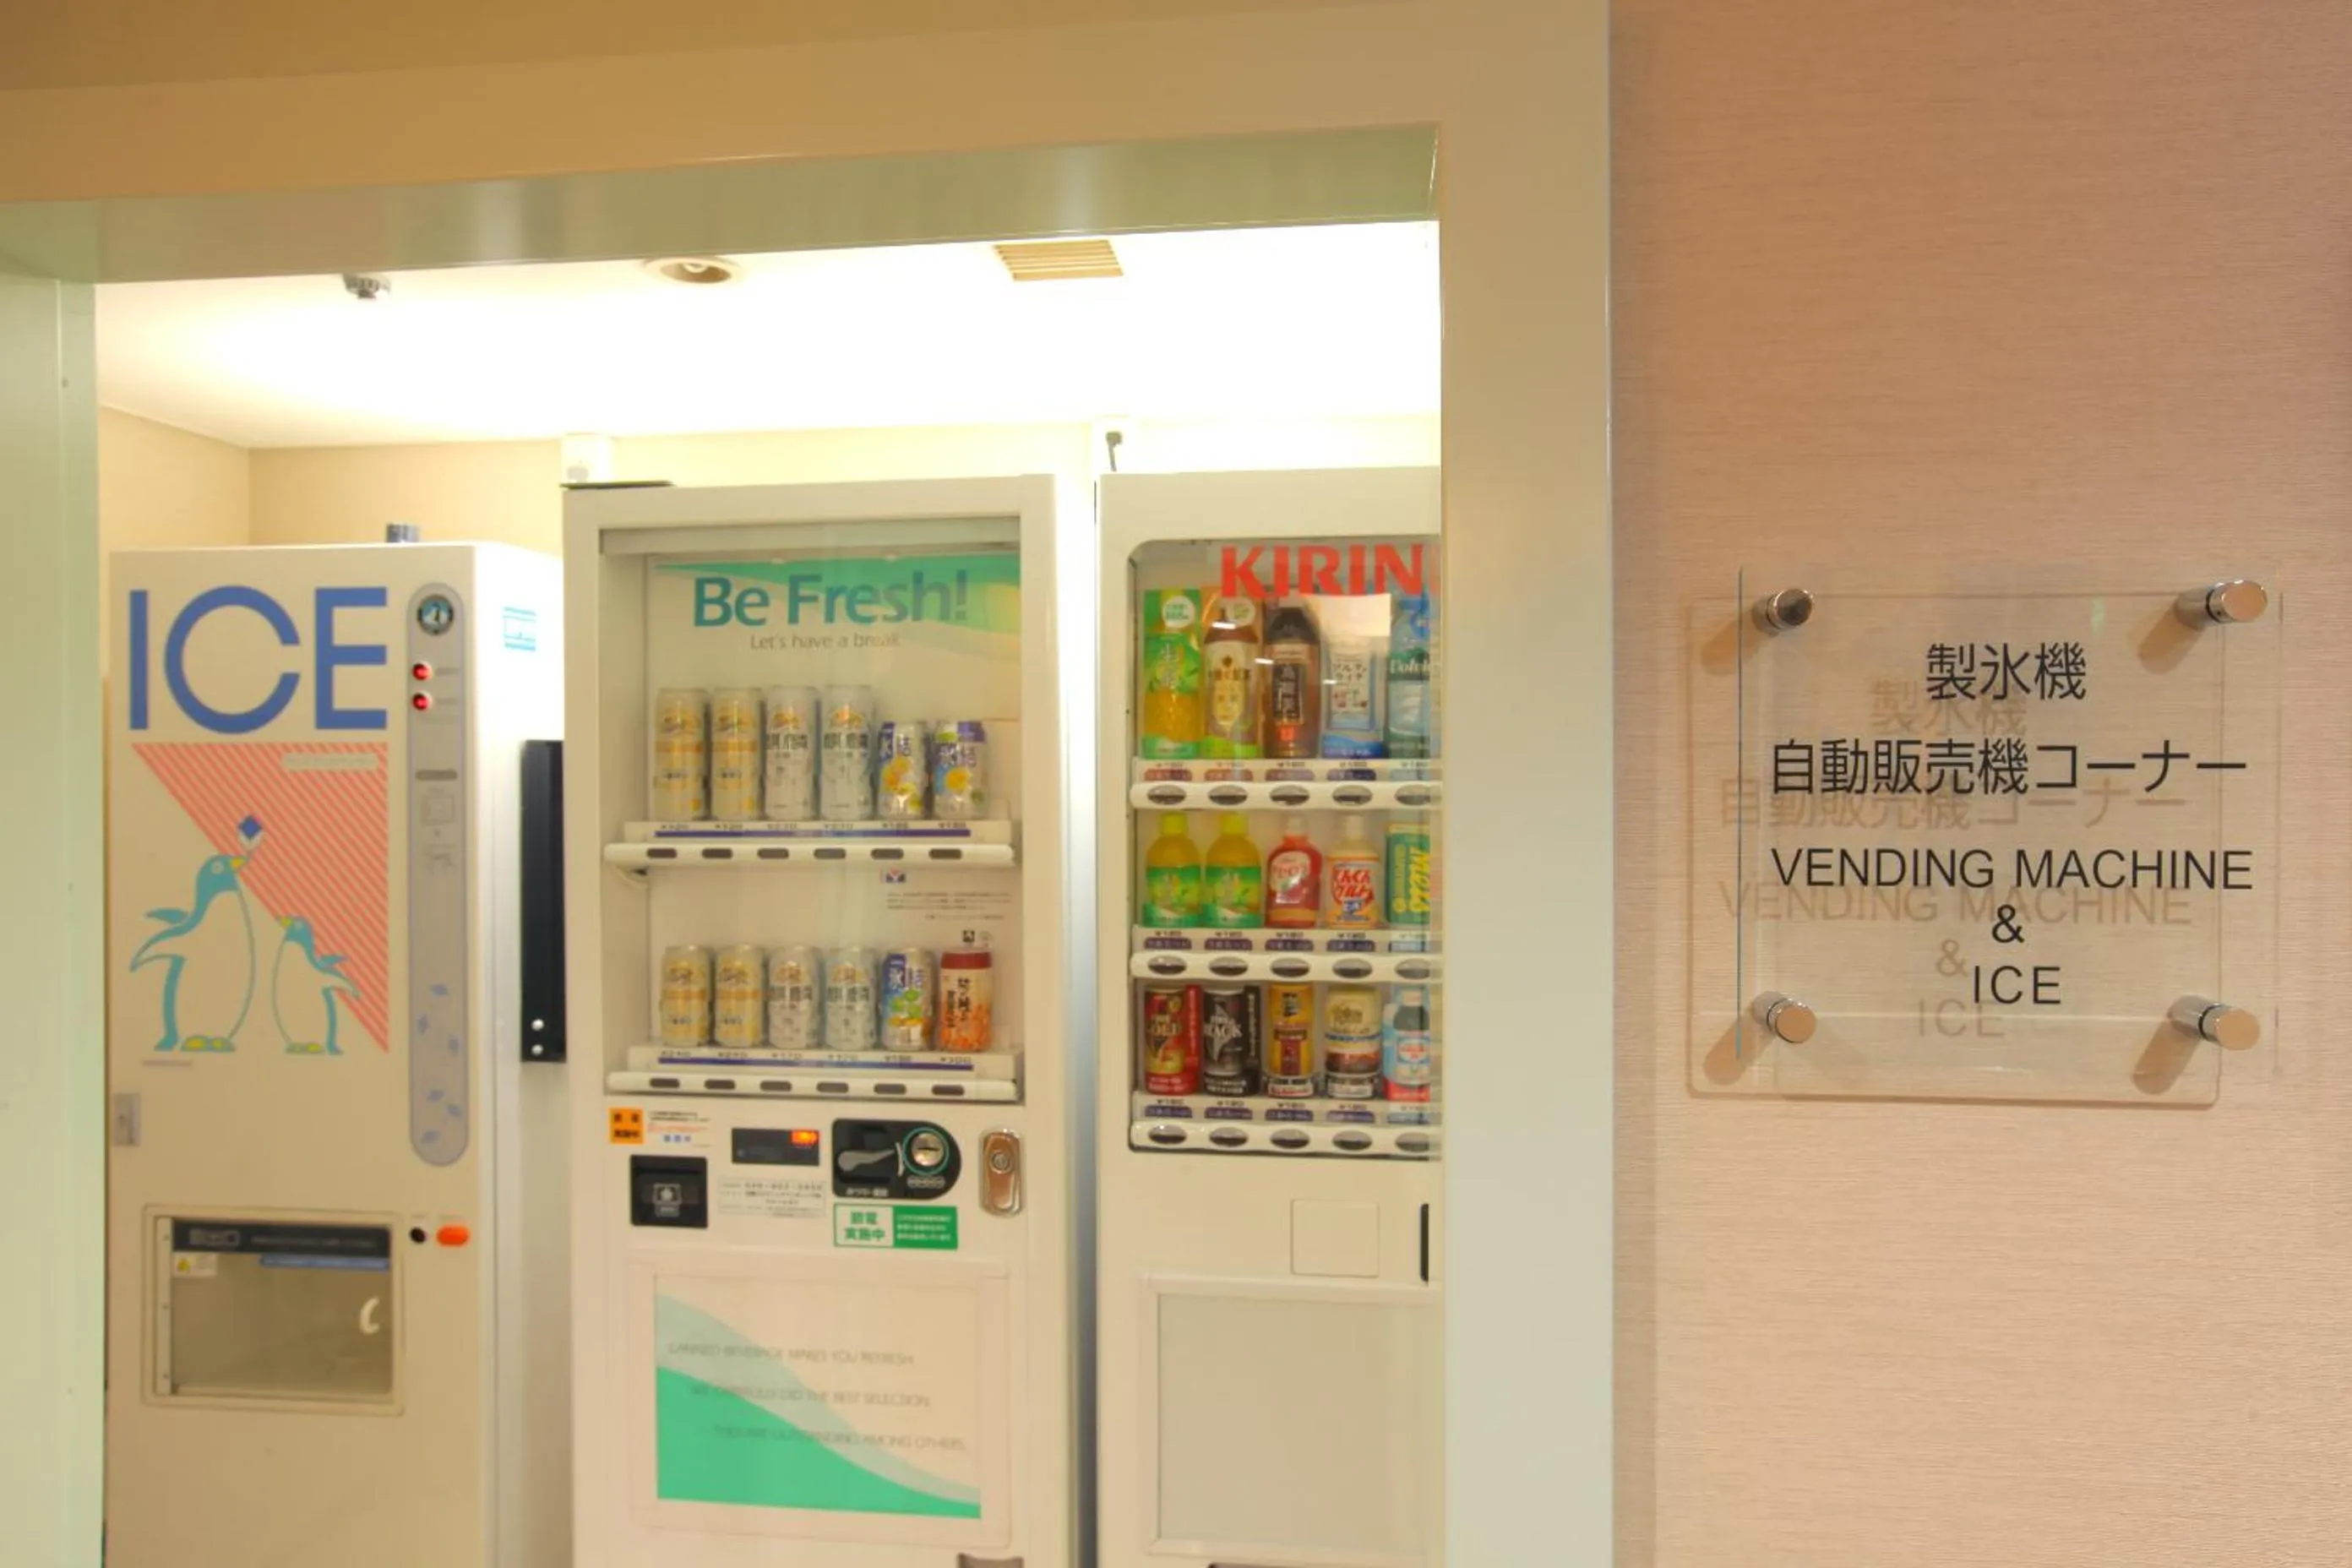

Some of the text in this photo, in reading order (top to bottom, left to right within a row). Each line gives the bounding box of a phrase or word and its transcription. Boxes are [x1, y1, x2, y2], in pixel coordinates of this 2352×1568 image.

[694, 569, 967, 627] Be Fresh!
[1220, 543, 1424, 599] KIRIN
[129, 585, 388, 734] ICE
[750, 634, 787, 650] Let's
[792, 634, 833, 649] have
[836, 636, 848, 648] a
[1926, 642, 2087, 701] 製氷機
[1772, 738, 2246, 796] 自動販売機コーナー
[1771, 847, 2253, 890] VENDING MACHINE
[1991, 904, 2024, 944] &
[1974, 965, 2061, 1004] ICE
